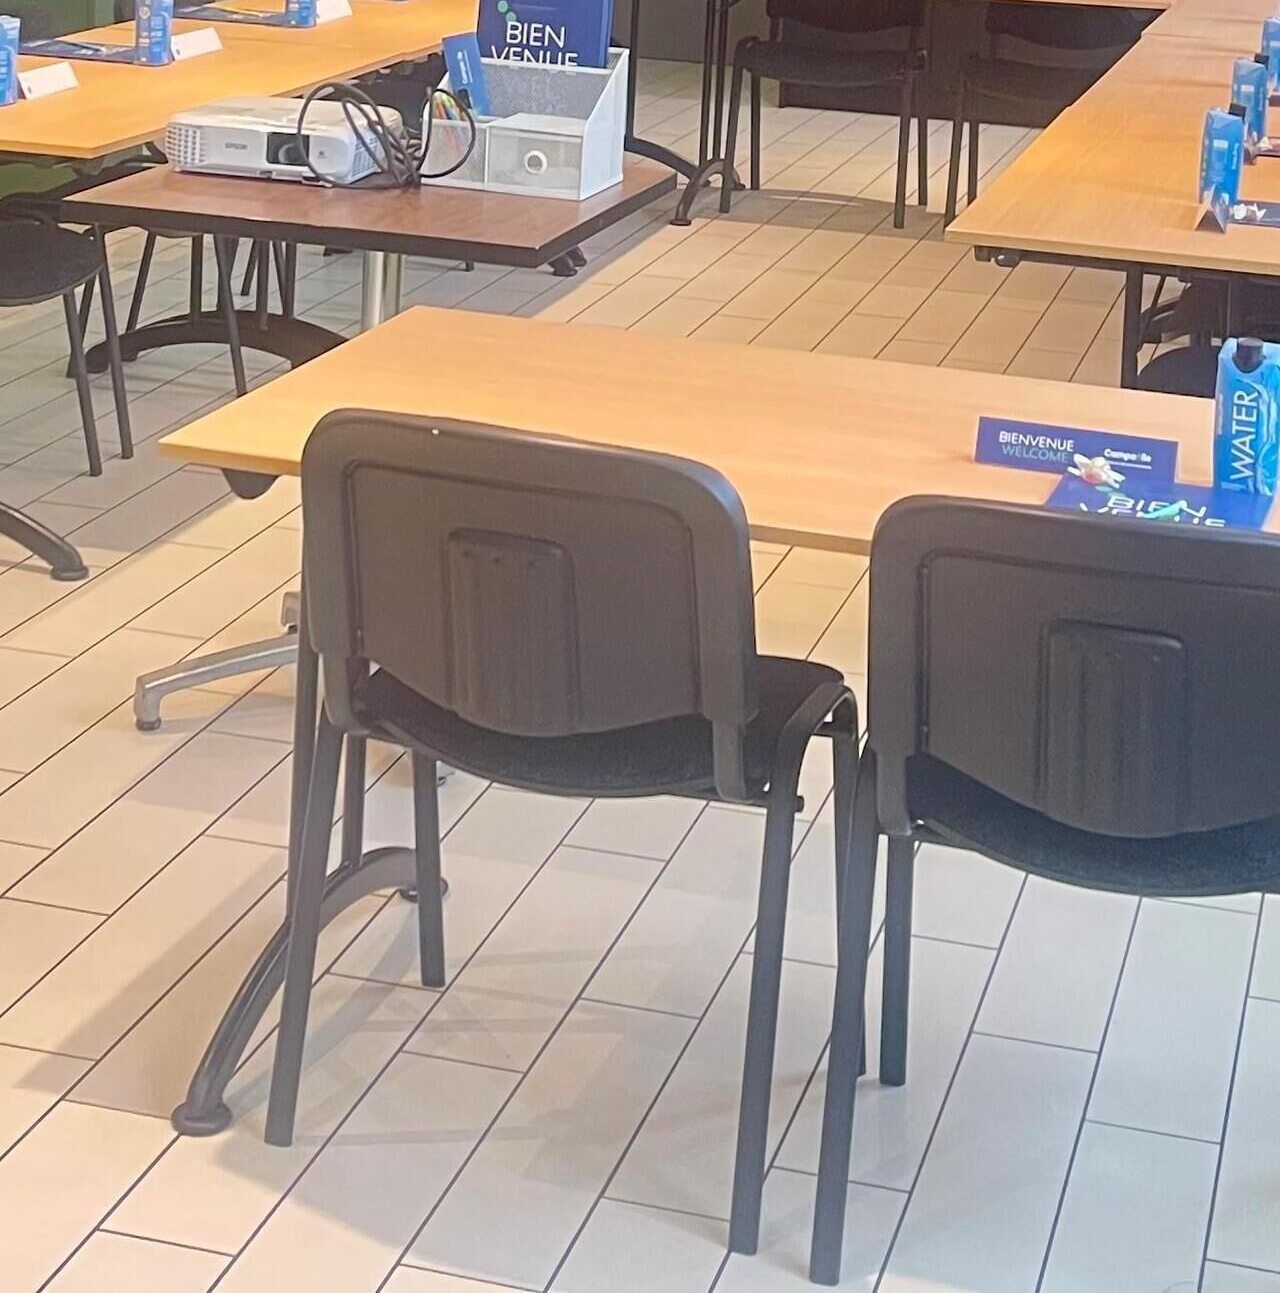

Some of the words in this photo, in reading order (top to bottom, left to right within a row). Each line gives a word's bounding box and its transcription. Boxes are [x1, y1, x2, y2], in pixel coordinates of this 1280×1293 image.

[506, 21, 565, 49] BIEN
[998, 430, 1075, 452] BIENVENUE
[1229, 390, 1259, 480] WATER
[1001, 444, 1069, 464] WELCOME
